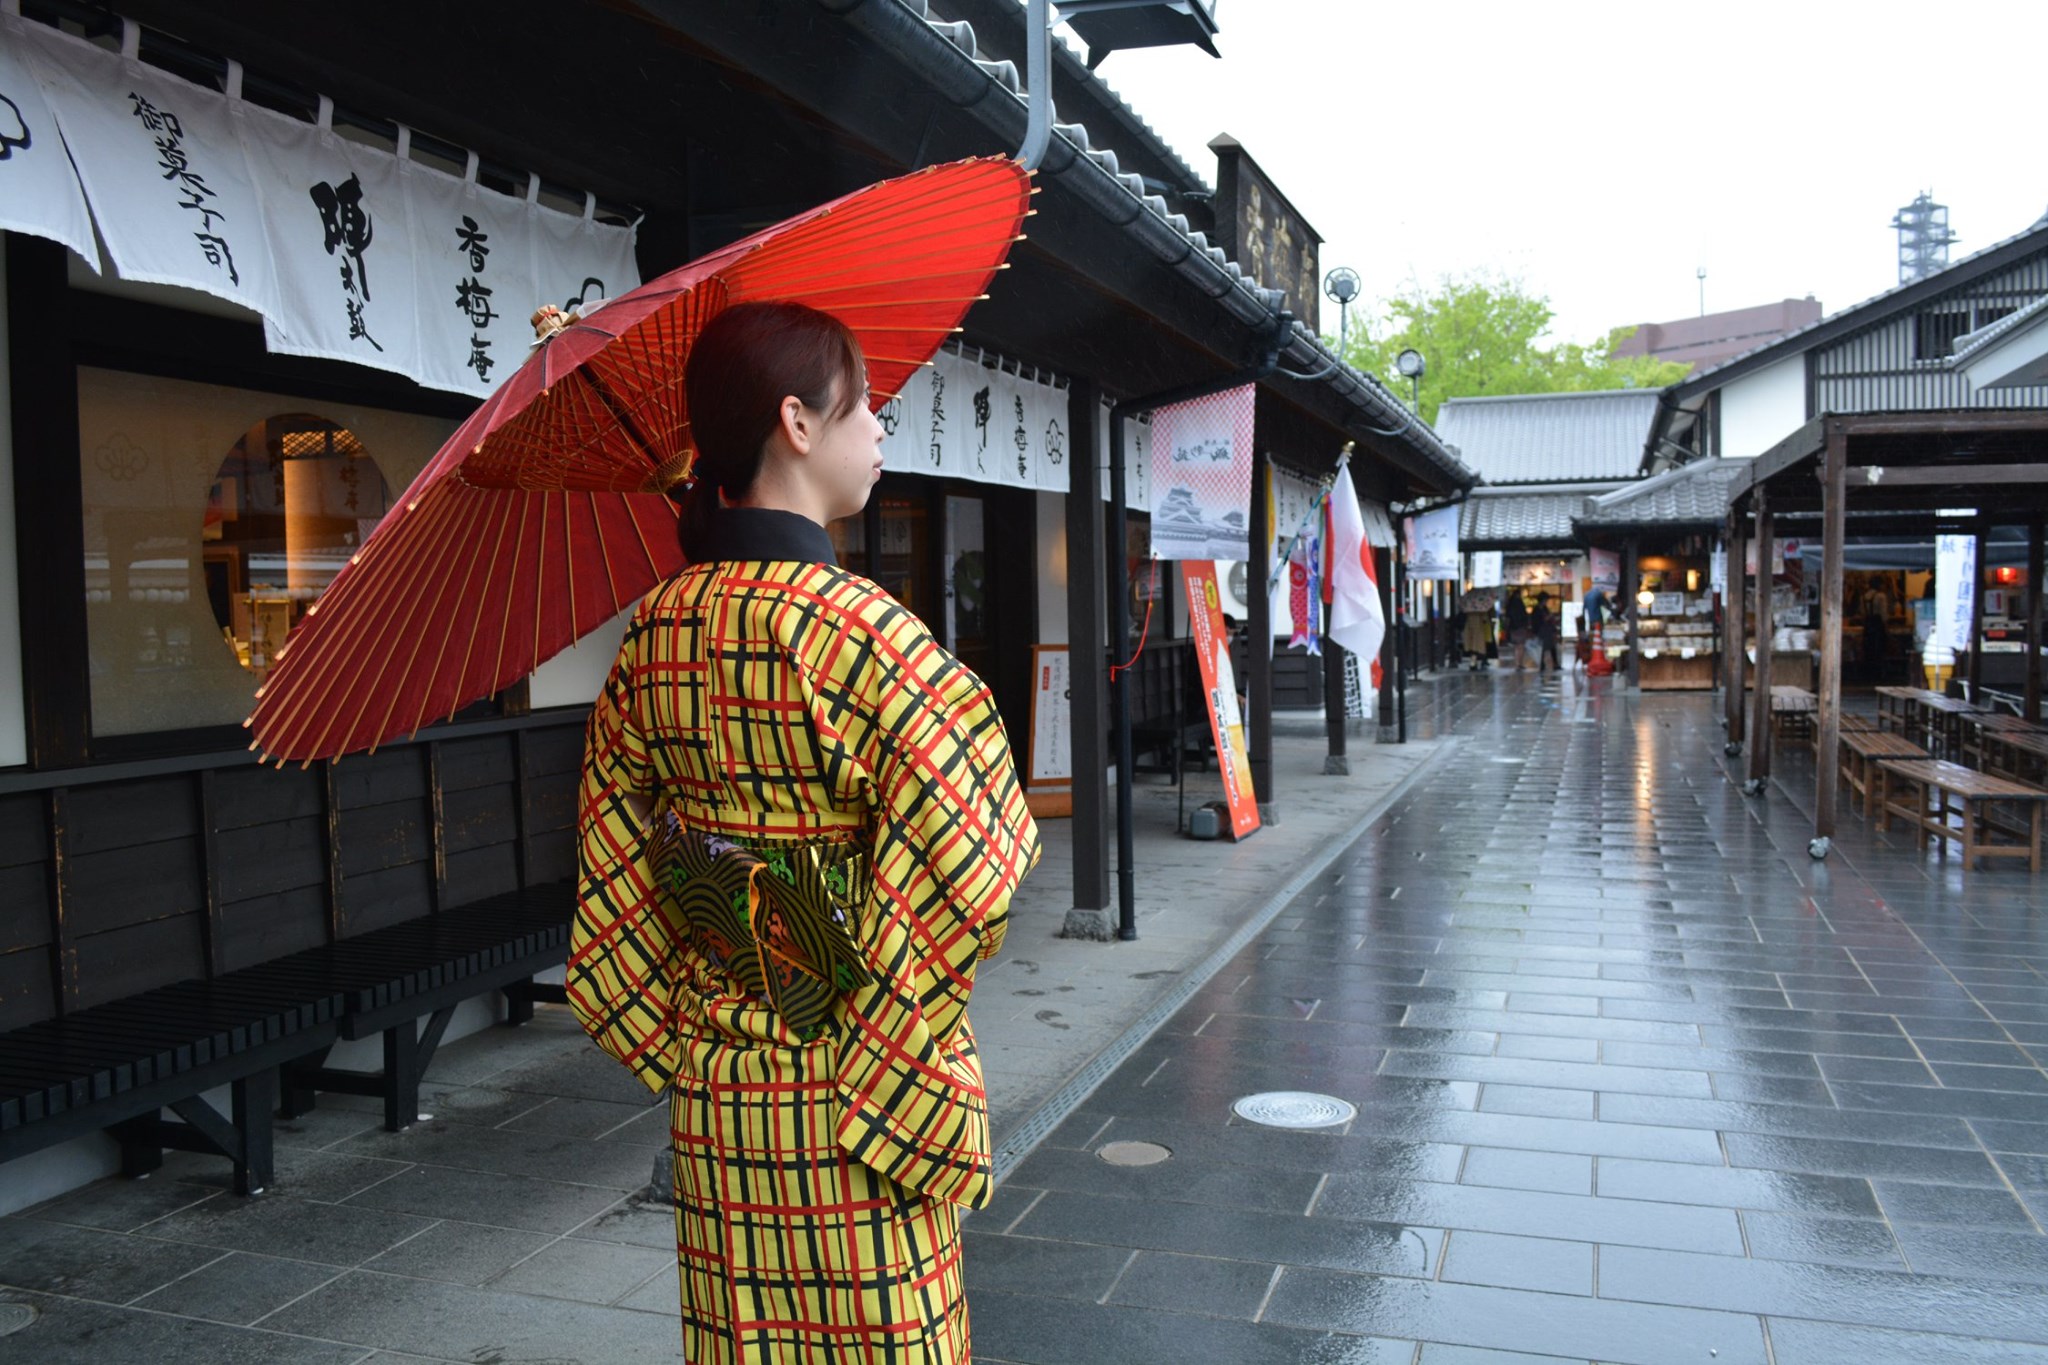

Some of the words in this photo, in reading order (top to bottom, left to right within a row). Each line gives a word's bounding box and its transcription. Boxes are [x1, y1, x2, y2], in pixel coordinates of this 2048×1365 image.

[128, 91, 239, 287] 御菓子司
[309, 172, 384, 352] 陣太鼓
[455, 214, 499, 384] 香梅庵
